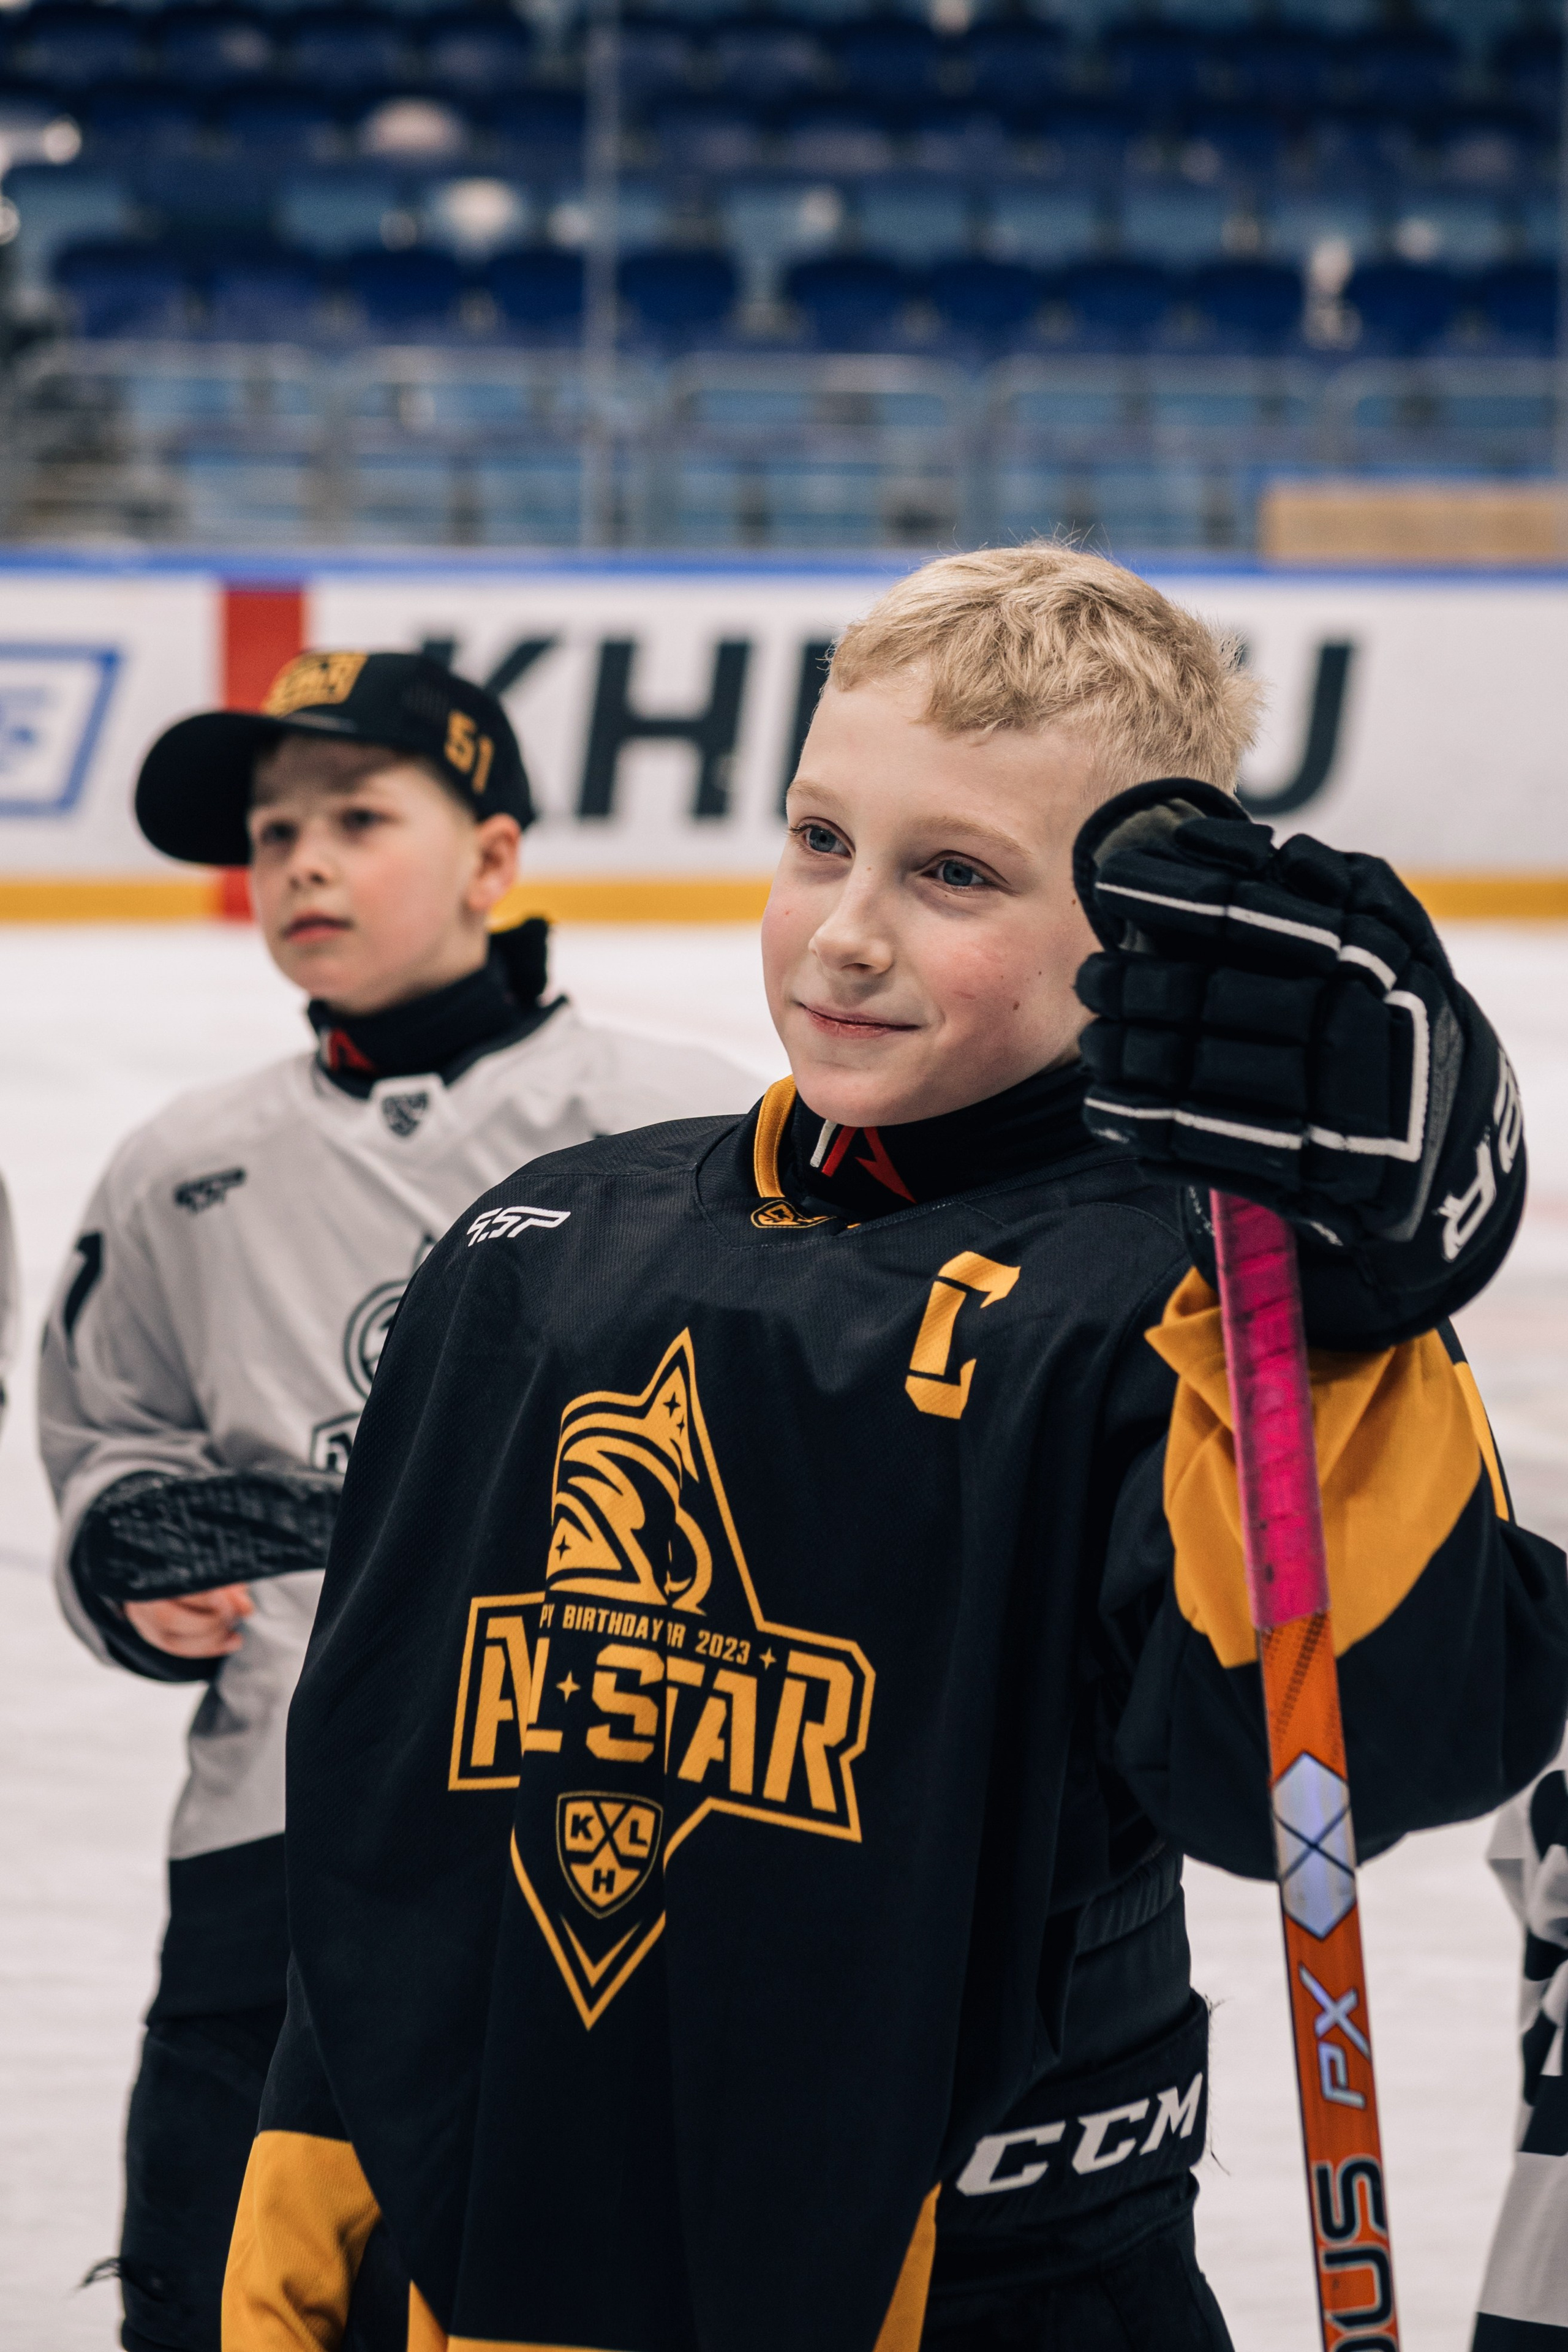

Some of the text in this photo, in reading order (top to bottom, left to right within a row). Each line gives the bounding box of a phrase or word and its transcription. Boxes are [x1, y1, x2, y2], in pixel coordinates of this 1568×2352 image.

[905, 1251, 1022, 1420] C
[562, 1604, 663, 1642] BIRTHDAY
[695, 1629, 751, 1665] 2023
[1298, 1961, 1372, 2109] PX
[956, 2071, 1203, 2196] CCM
